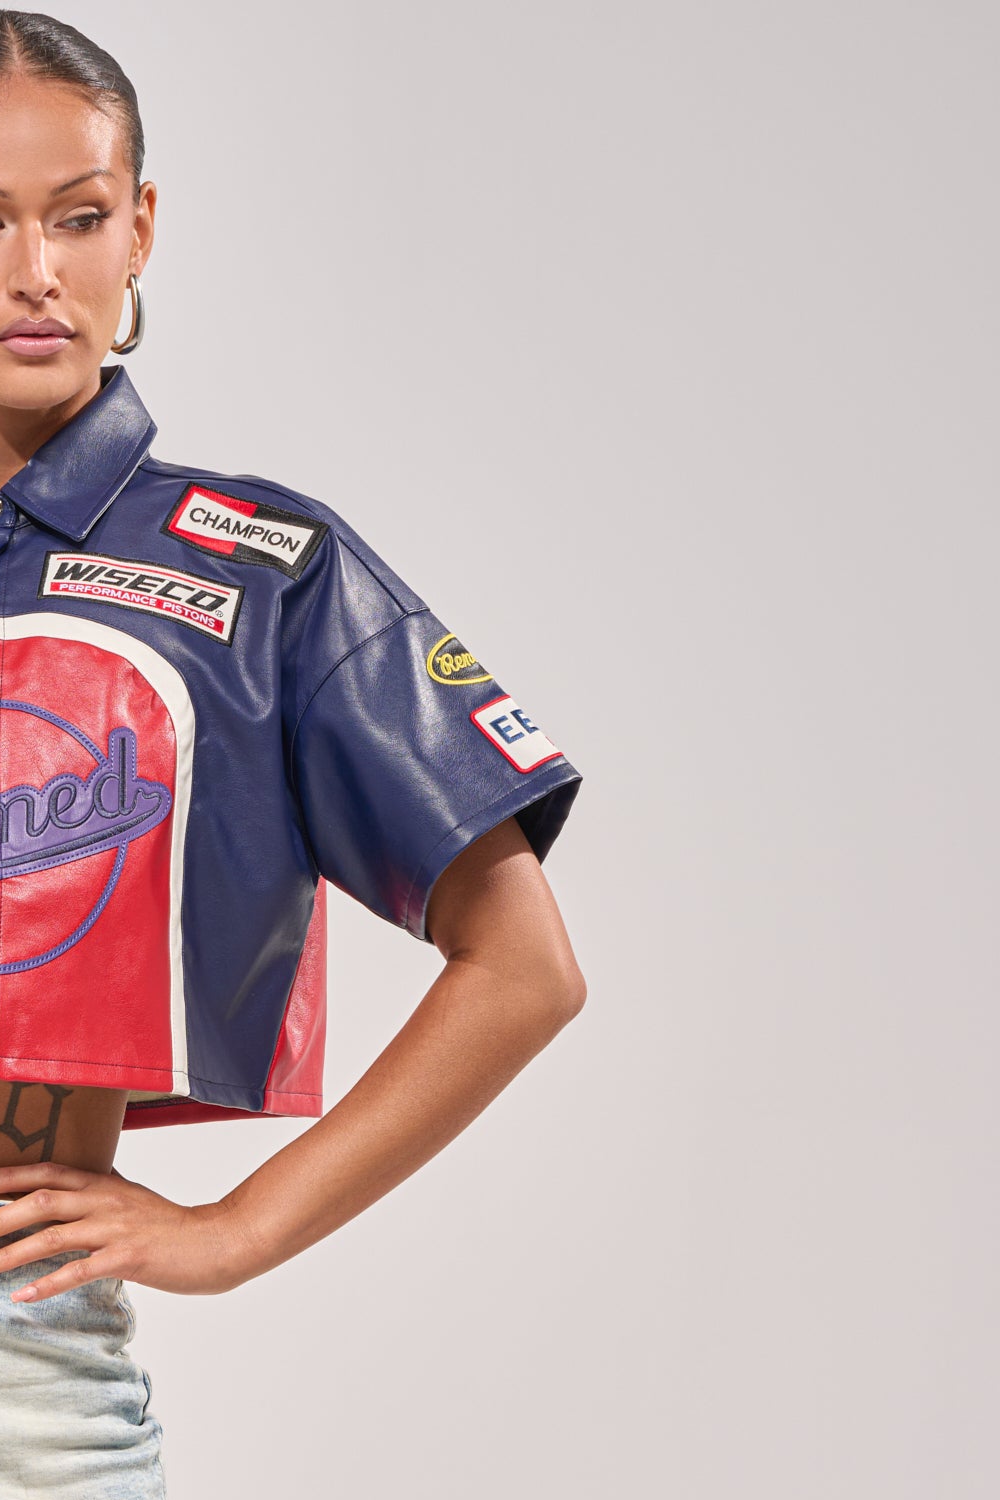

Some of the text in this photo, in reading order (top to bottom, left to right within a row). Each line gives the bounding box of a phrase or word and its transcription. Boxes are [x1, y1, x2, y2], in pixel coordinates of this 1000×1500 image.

[189, 506, 301, 553] CHAMPION
[59, 583, 216, 629] PERFORMANCE PISTONS
